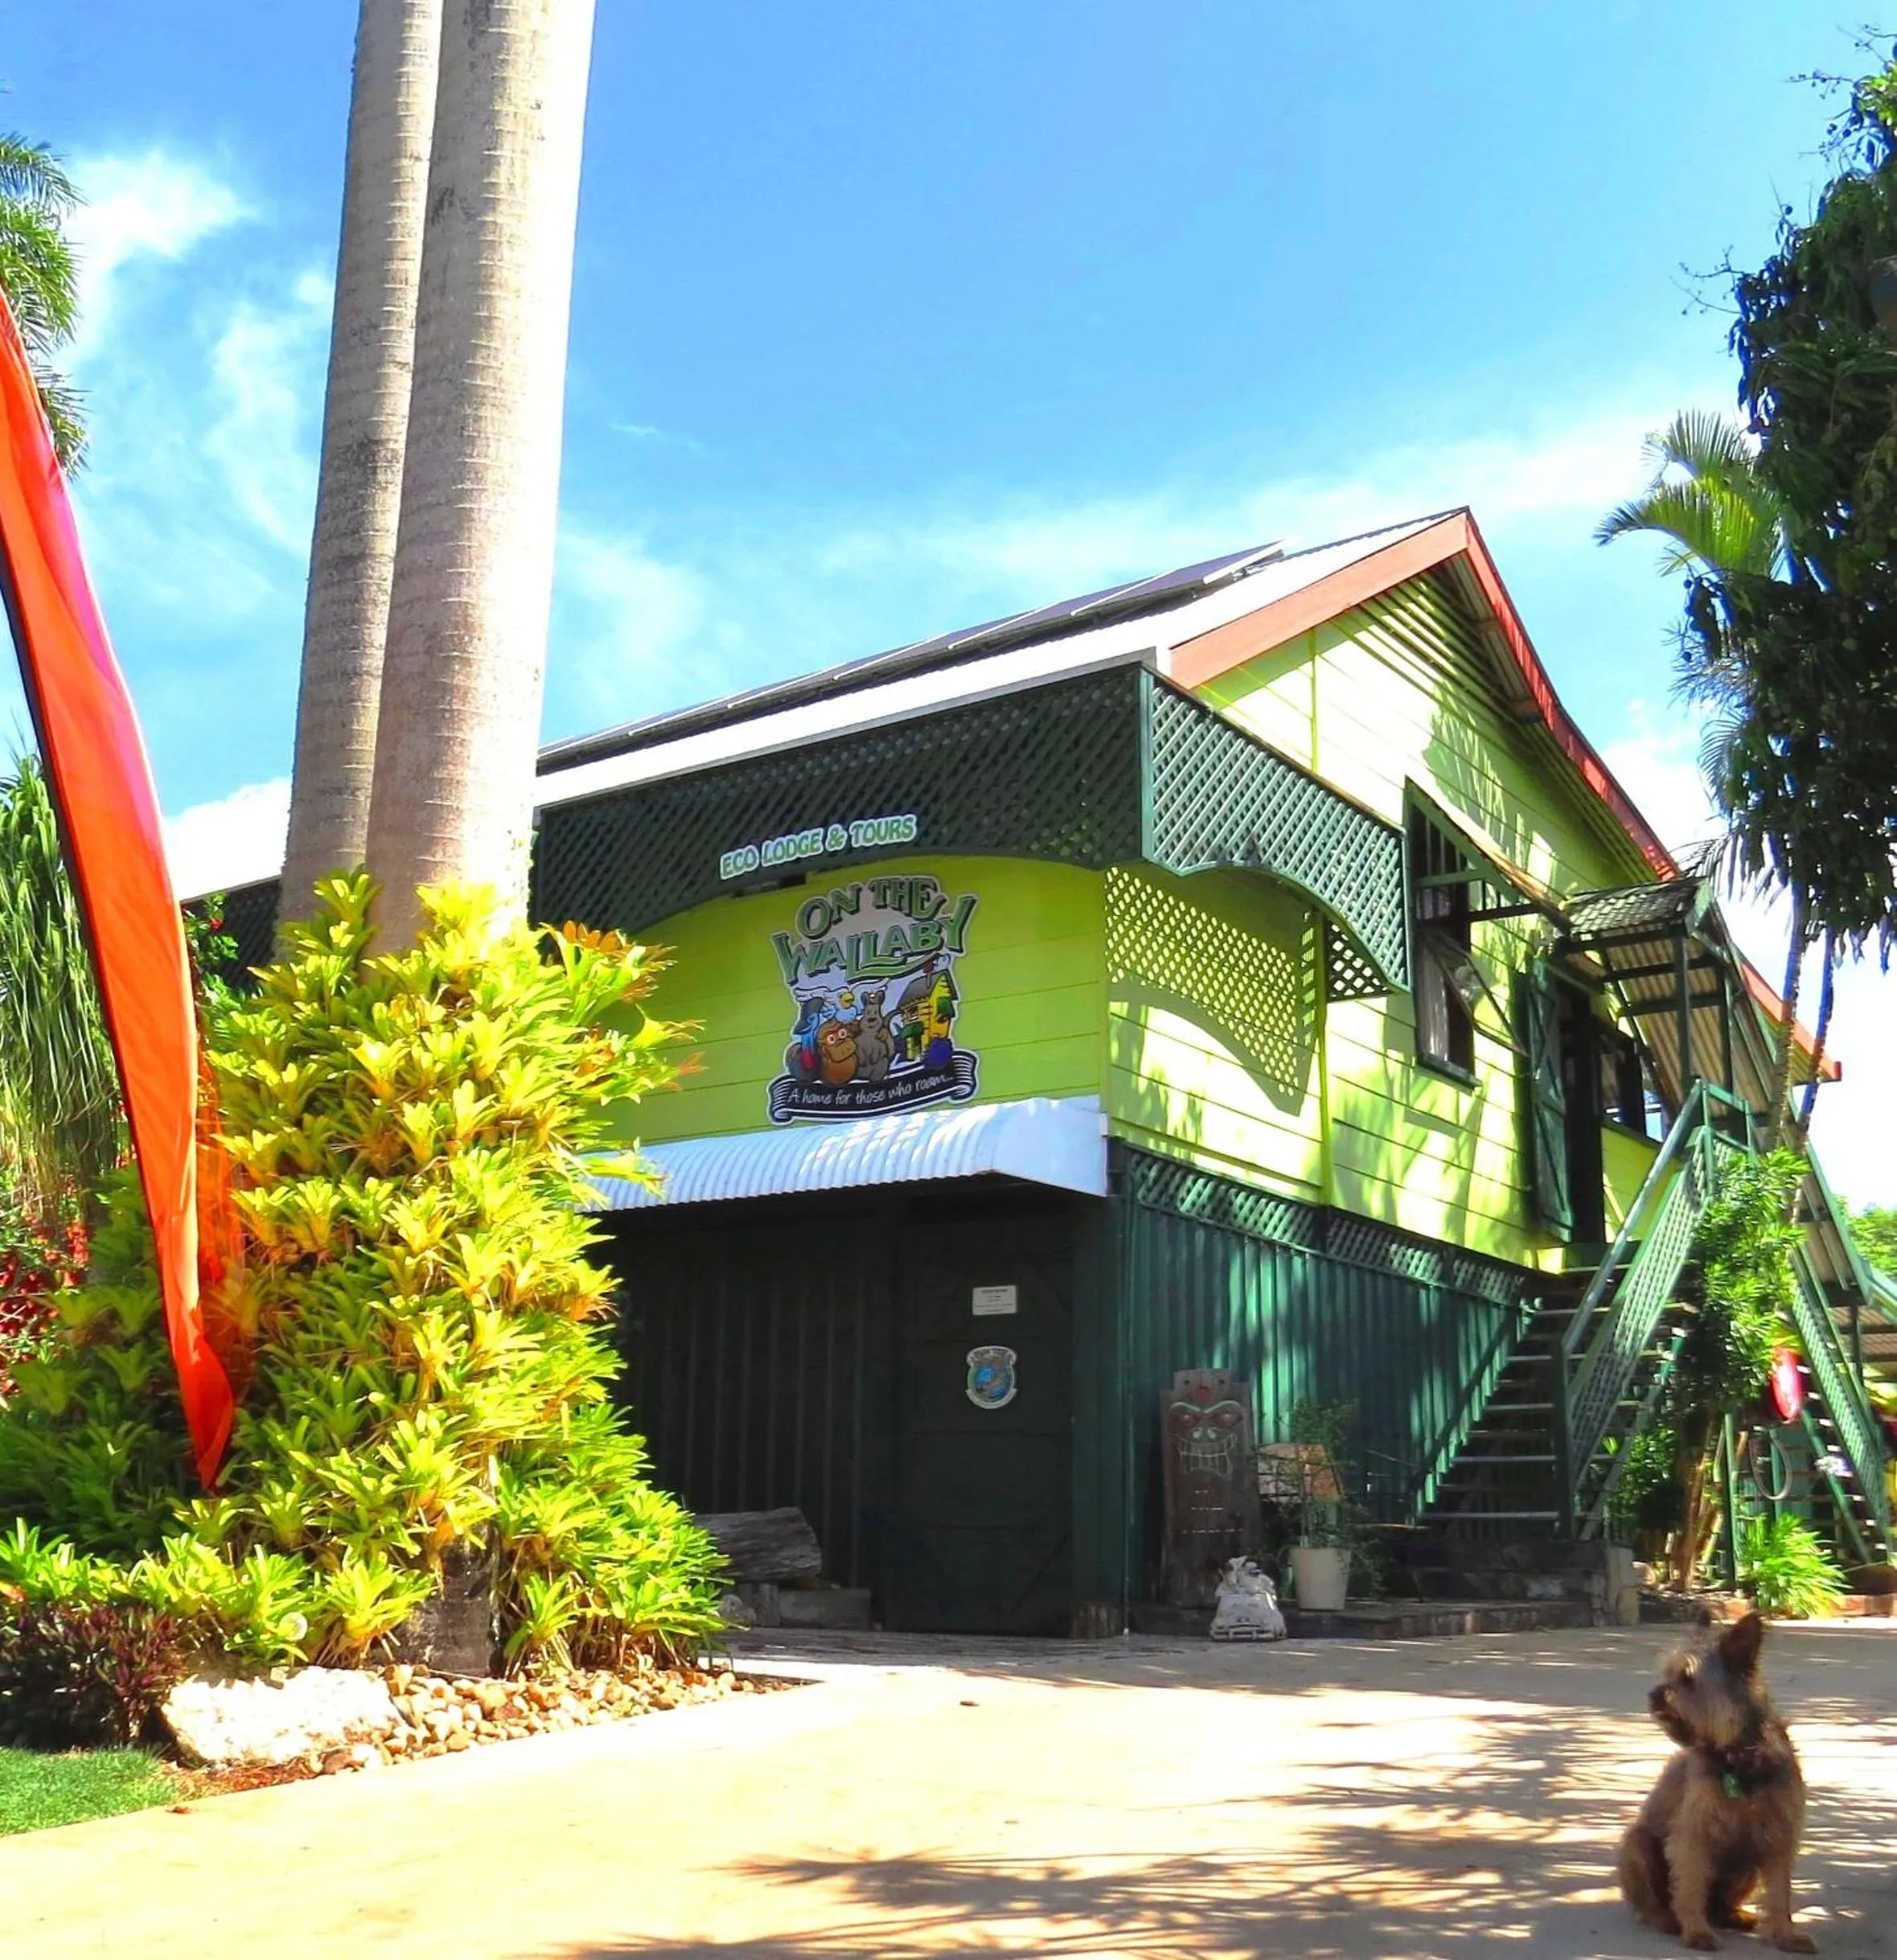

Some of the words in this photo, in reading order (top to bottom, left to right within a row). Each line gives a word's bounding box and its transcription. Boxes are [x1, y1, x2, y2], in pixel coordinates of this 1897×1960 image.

[721, 846, 760, 880] ECO
[762, 828, 824, 867] LODGE
[826, 824, 848, 851] &
[849, 814, 917, 847] TOURS
[797, 885, 864, 939] ON
[868, 877, 948, 922] THE
[772, 894, 977, 987] WALLABY
[787, 1088, 800, 1103] A
[802, 1087, 832, 1105] home
[836, 1089, 852, 1105] for
[856, 1087, 885, 1104] those
[888, 1081, 913, 1099] who
